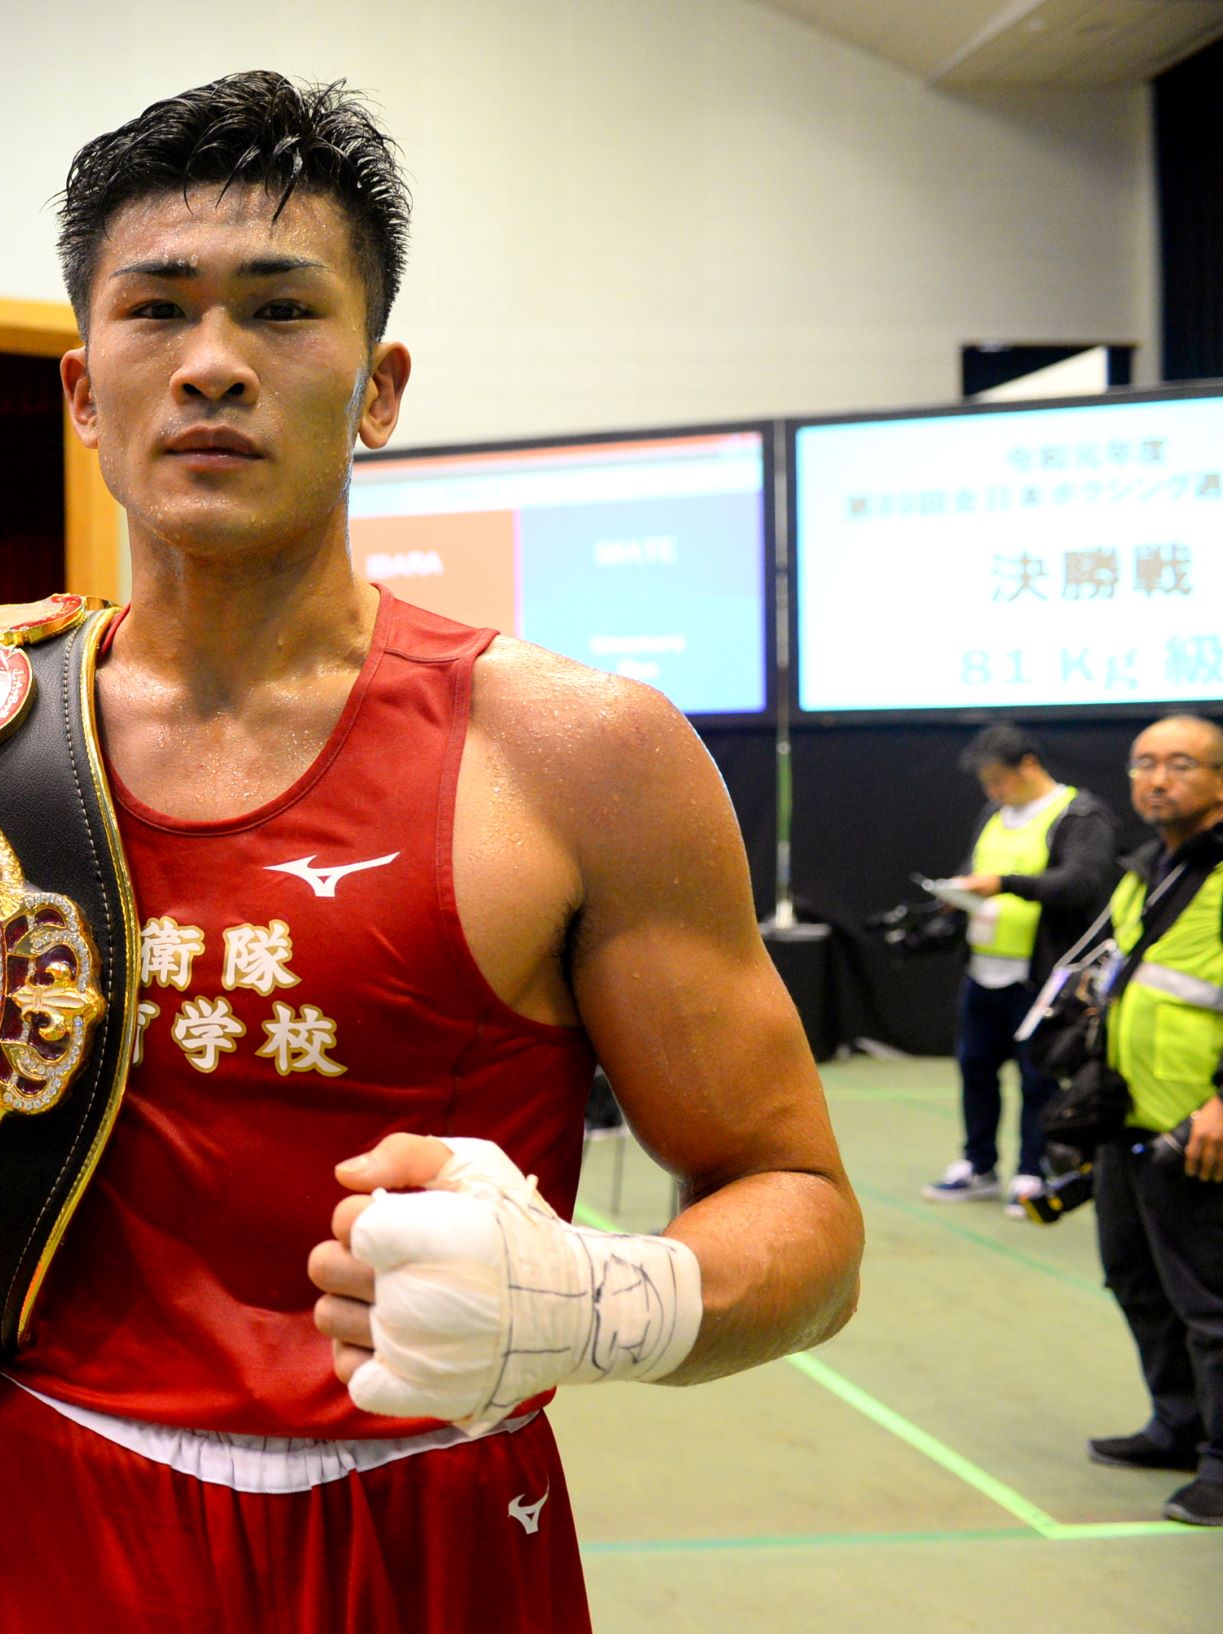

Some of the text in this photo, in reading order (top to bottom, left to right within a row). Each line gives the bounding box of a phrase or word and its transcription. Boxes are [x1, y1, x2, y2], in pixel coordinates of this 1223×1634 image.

[845, 473, 1222, 520] 第回全日本ボクシング選
[992, 543, 1192, 602] 決勝戦
[960, 648, 1032, 686] 81
[1059, 646, 1138, 691] Kg
